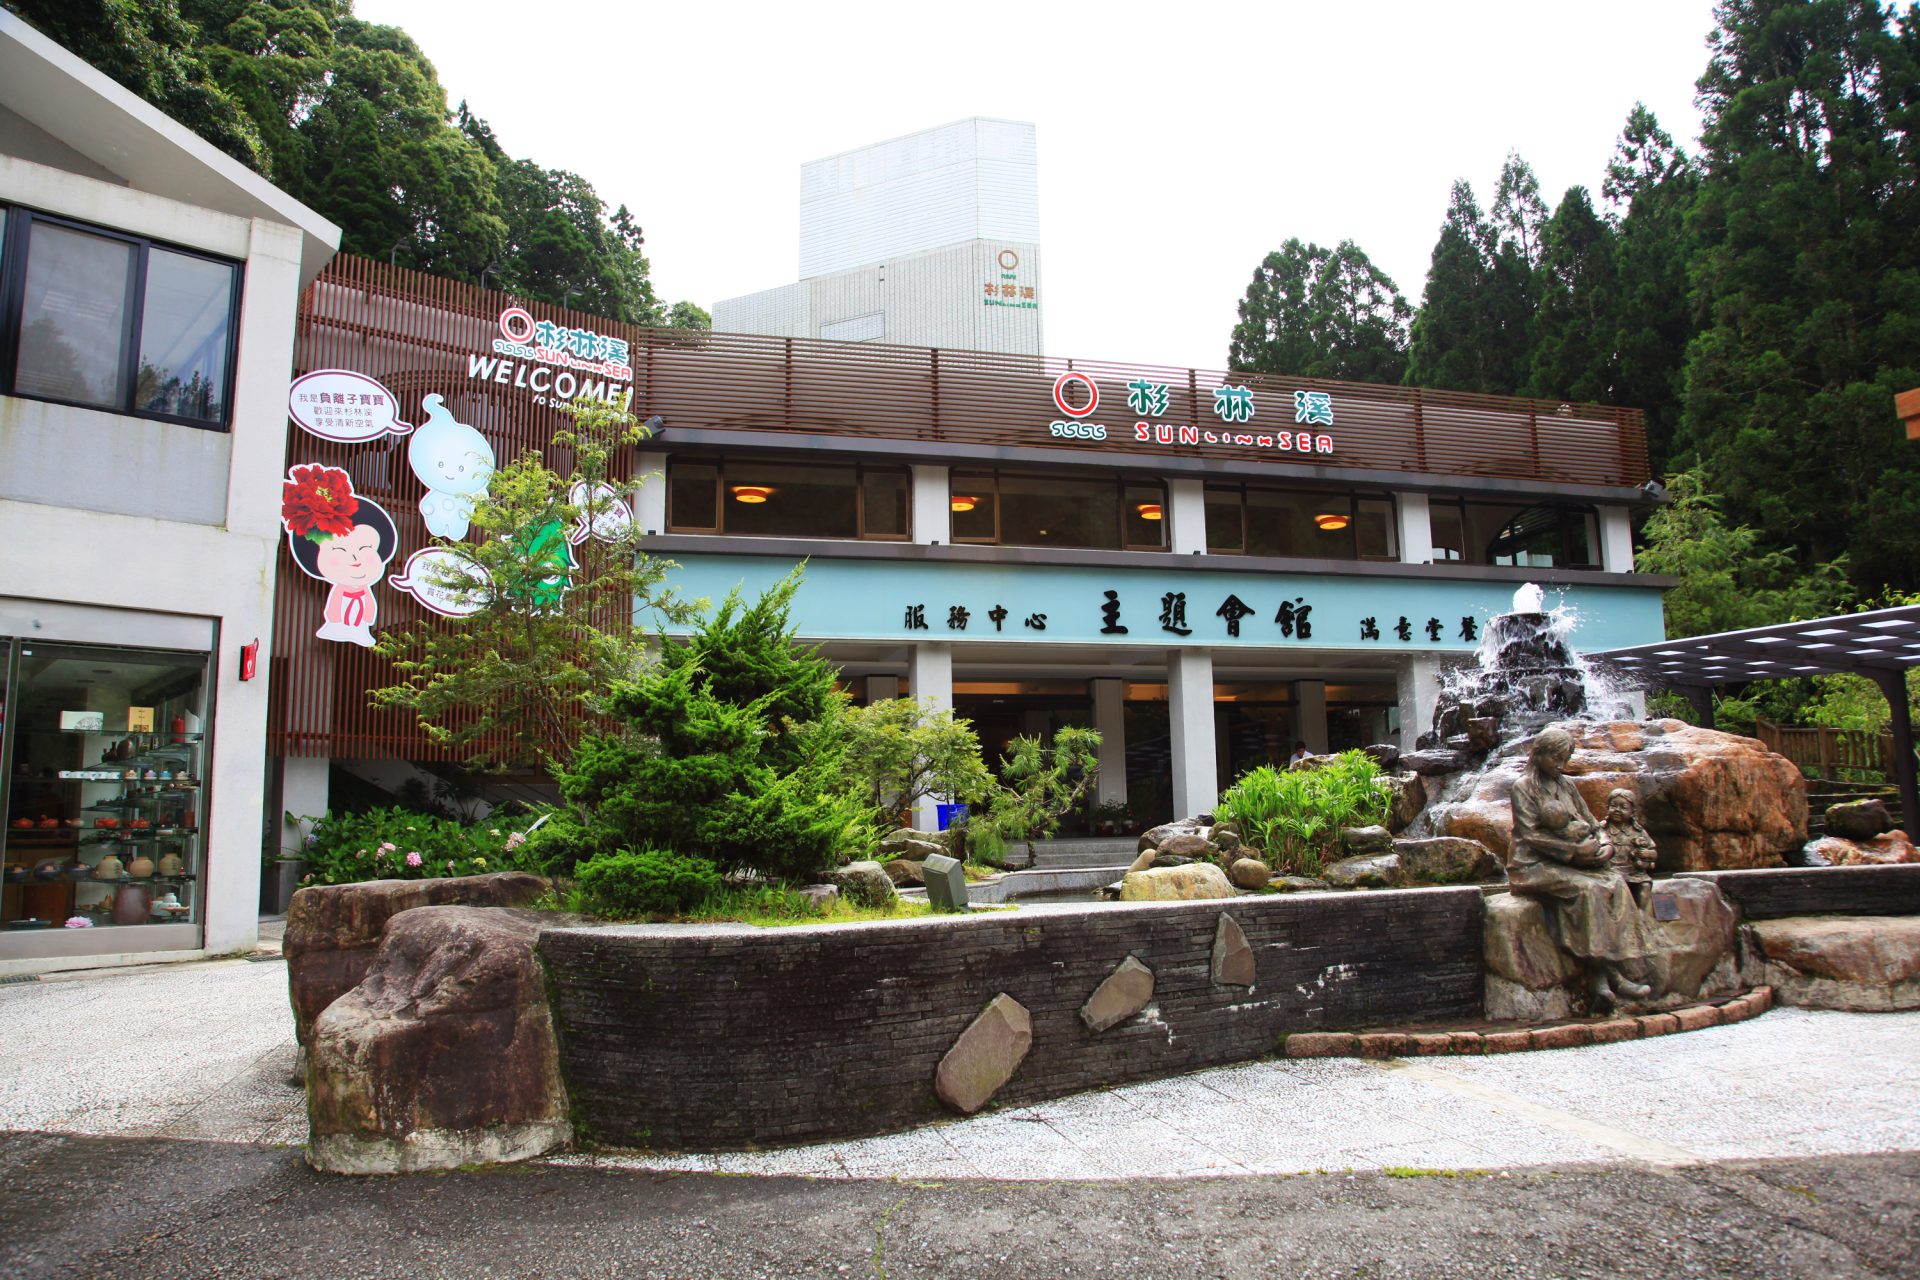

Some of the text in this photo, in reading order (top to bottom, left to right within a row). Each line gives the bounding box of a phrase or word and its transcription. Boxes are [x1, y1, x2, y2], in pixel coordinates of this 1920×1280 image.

[536, 320, 628, 366] 杉林溪
[536, 348, 633, 381] SUN LINK SEA
[468, 354, 634, 422] WELCOME!
[533, 394, 546, 405] to
[1127, 378, 1334, 426] 杉林溪
[1135, 421, 1333, 454] SUN LINK SEA
[904, 603, 1048, 632] 服務中心
[1100, 590, 1313, 639] 主題會館
